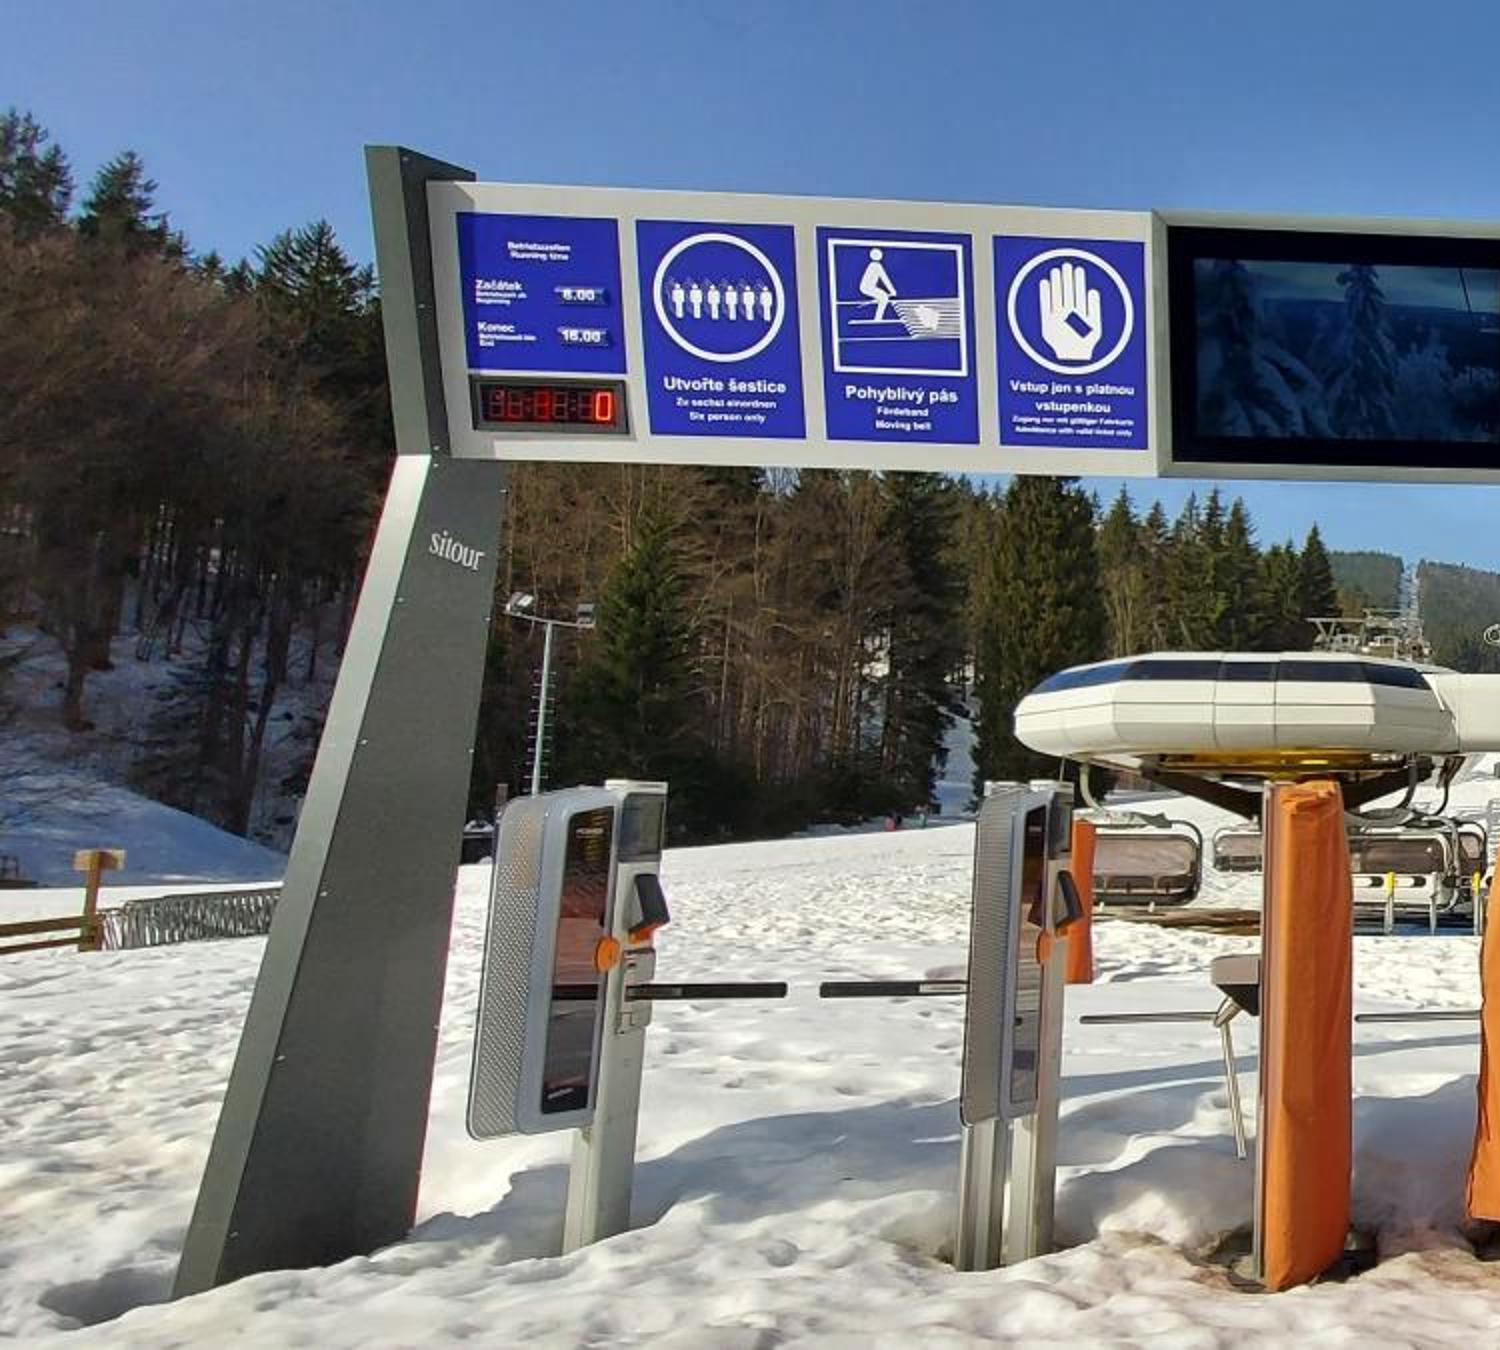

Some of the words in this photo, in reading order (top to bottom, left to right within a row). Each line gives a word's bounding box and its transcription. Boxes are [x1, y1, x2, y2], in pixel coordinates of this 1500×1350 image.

[475, 279, 522, 291] Začátek
[477, 321, 515, 333] Konec
[663, 376, 724, 391] Utvořte
[728, 377, 788, 393] šestice
[1009, 379, 1049, 395] Vstup
[1051, 381, 1072, 395] jen
[1074, 383, 1083, 394] s
[1085, 382, 1135, 397] platnou
[845, 385, 925, 404] Pohyblivý
[928, 387, 959, 404] pás
[1034, 401, 1111, 414] vstupenkou
[707, 413, 742, 423] person
[743, 414, 766, 424] only
[875, 419, 911, 432] Moving
[912, 420, 933, 431] belt
[428, 529, 486, 571] sitour
